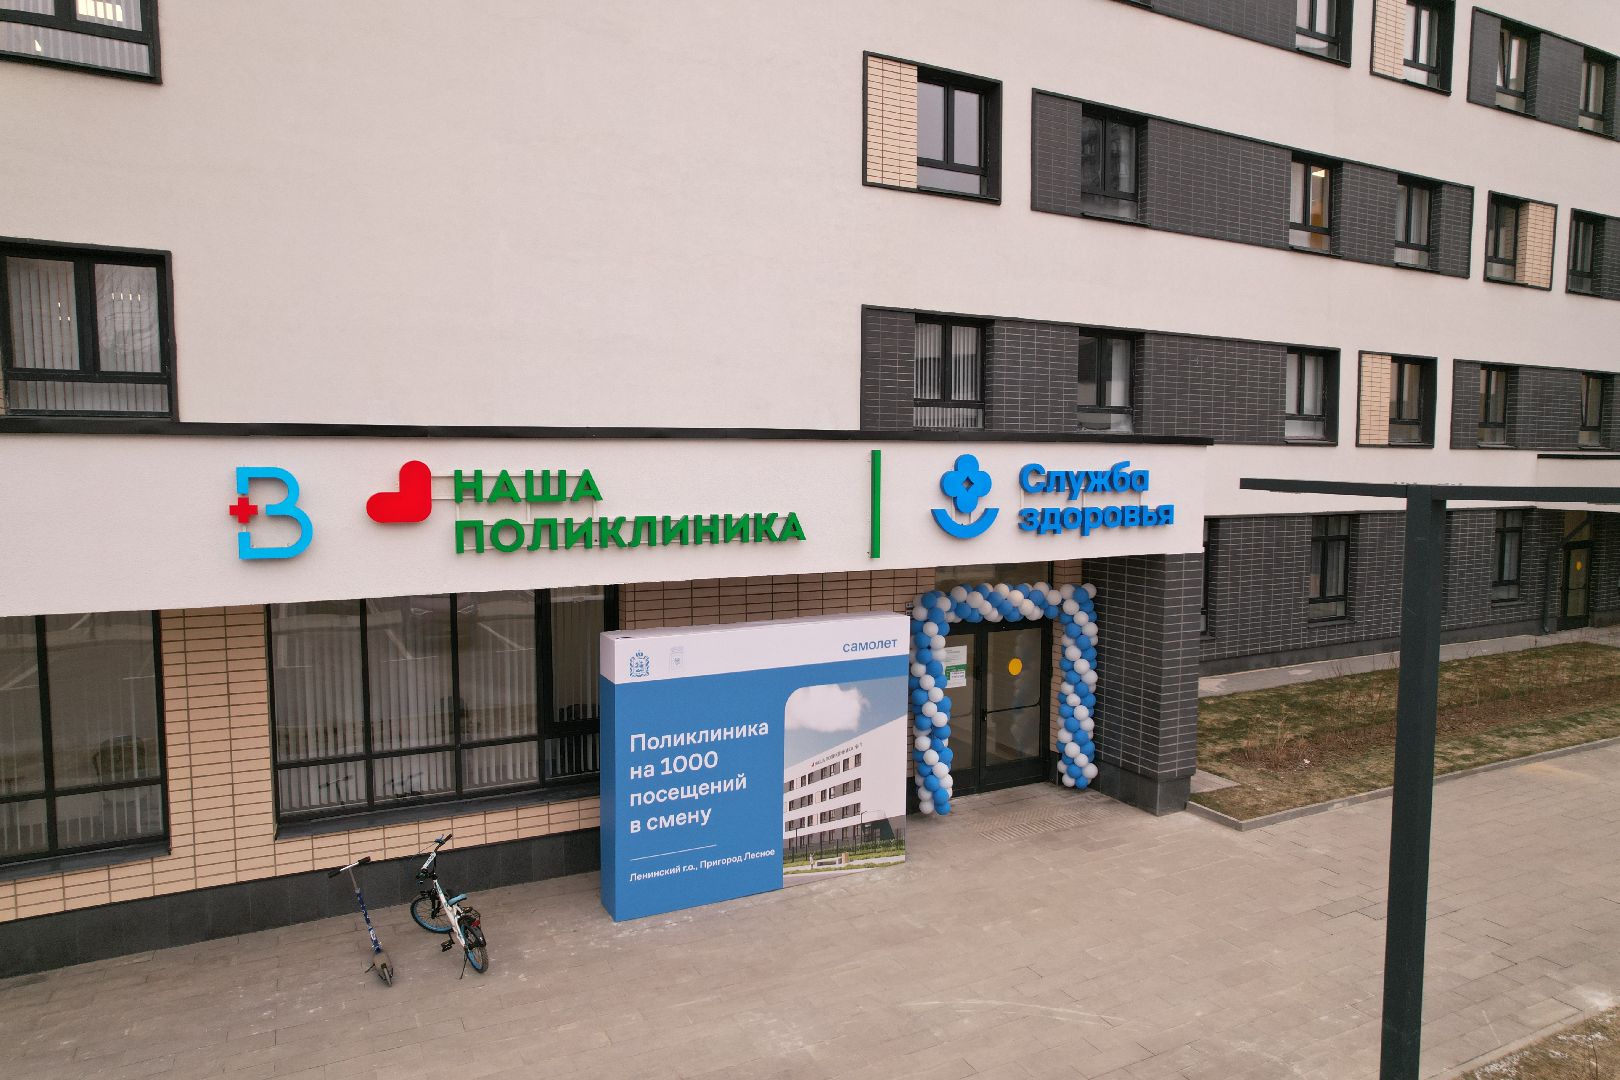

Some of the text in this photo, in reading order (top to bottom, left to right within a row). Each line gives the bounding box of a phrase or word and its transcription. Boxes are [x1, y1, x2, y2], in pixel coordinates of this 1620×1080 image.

[454, 469, 603, 503] НАША
[1019, 461, 1149, 501] Служба
[455, 511, 806, 554] ПОЛИКЛИНИКА
[1018, 504, 1175, 537] здоровья
[842, 638, 898, 653] самолет
[630, 721, 769, 752] Поликлиника
[630, 750, 719, 779] на 1000
[630, 773, 747, 807] посещений
[630, 808, 712, 834] в смену
[629, 865, 681, 882] Ленинский
[700, 854, 743, 869] Пригород
[743, 848, 776, 861] Лесное
